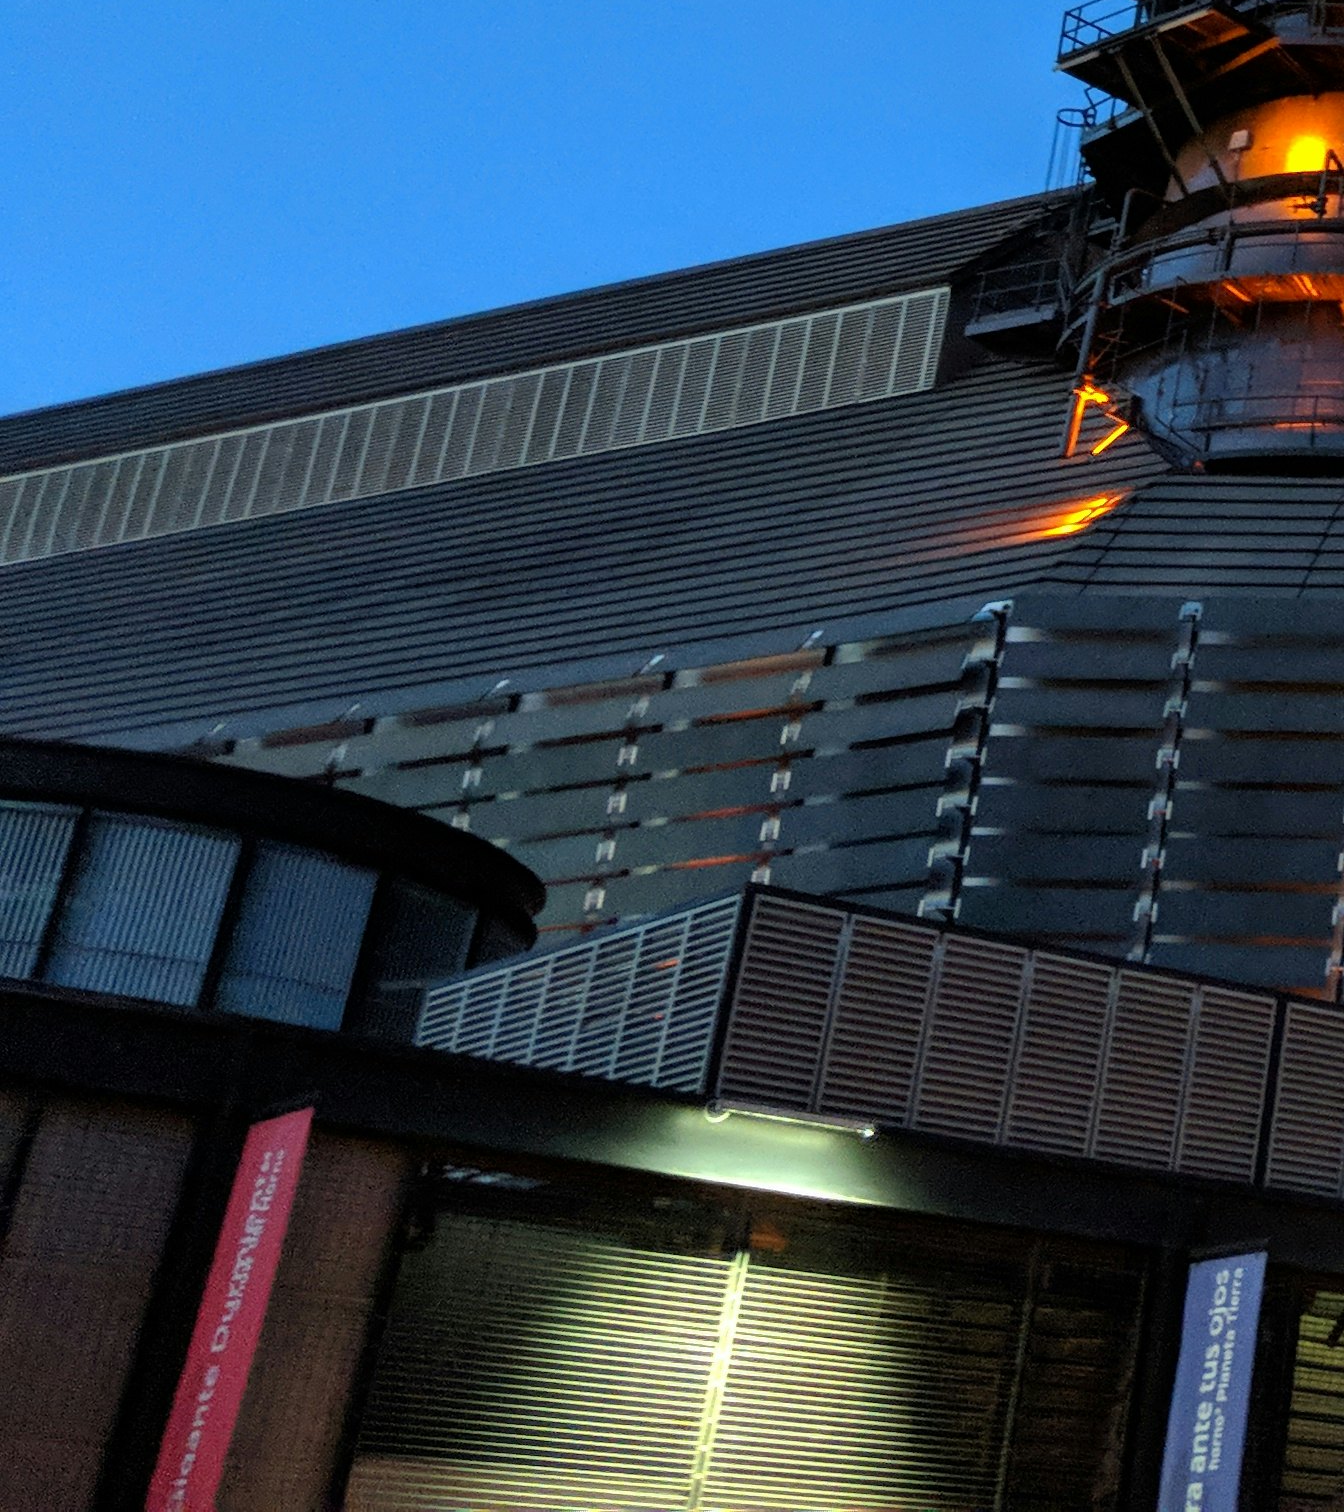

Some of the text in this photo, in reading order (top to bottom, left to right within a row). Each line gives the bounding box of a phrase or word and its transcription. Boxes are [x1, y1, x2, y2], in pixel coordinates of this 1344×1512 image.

[1207, 1269, 1230, 1337] ojos
[1225, 1268, 1245, 1324] Tierra
[1199, 1344, 1220, 1393] tus
[1216, 1330, 1237, 1402] Planeta
[1189, 1401, 1214, 1473] ante
